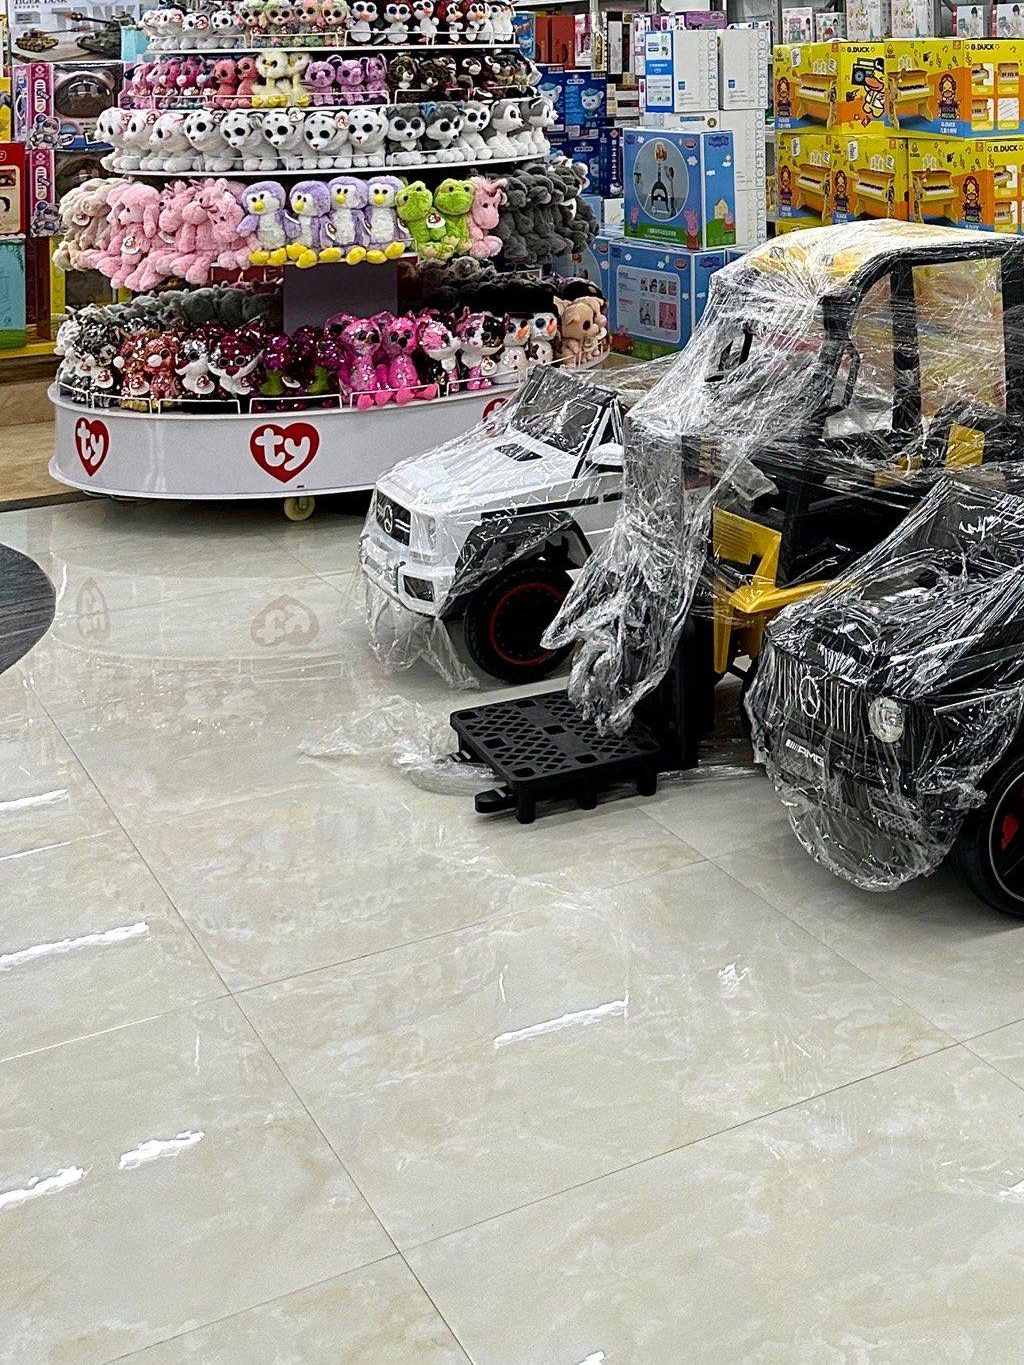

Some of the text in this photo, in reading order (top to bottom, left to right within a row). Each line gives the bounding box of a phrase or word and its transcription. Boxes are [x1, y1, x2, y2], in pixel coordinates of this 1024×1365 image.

[971, 43, 994, 51] G.DUCK
[77, 426, 104, 466] ty
[255, 428, 312, 471] ty
